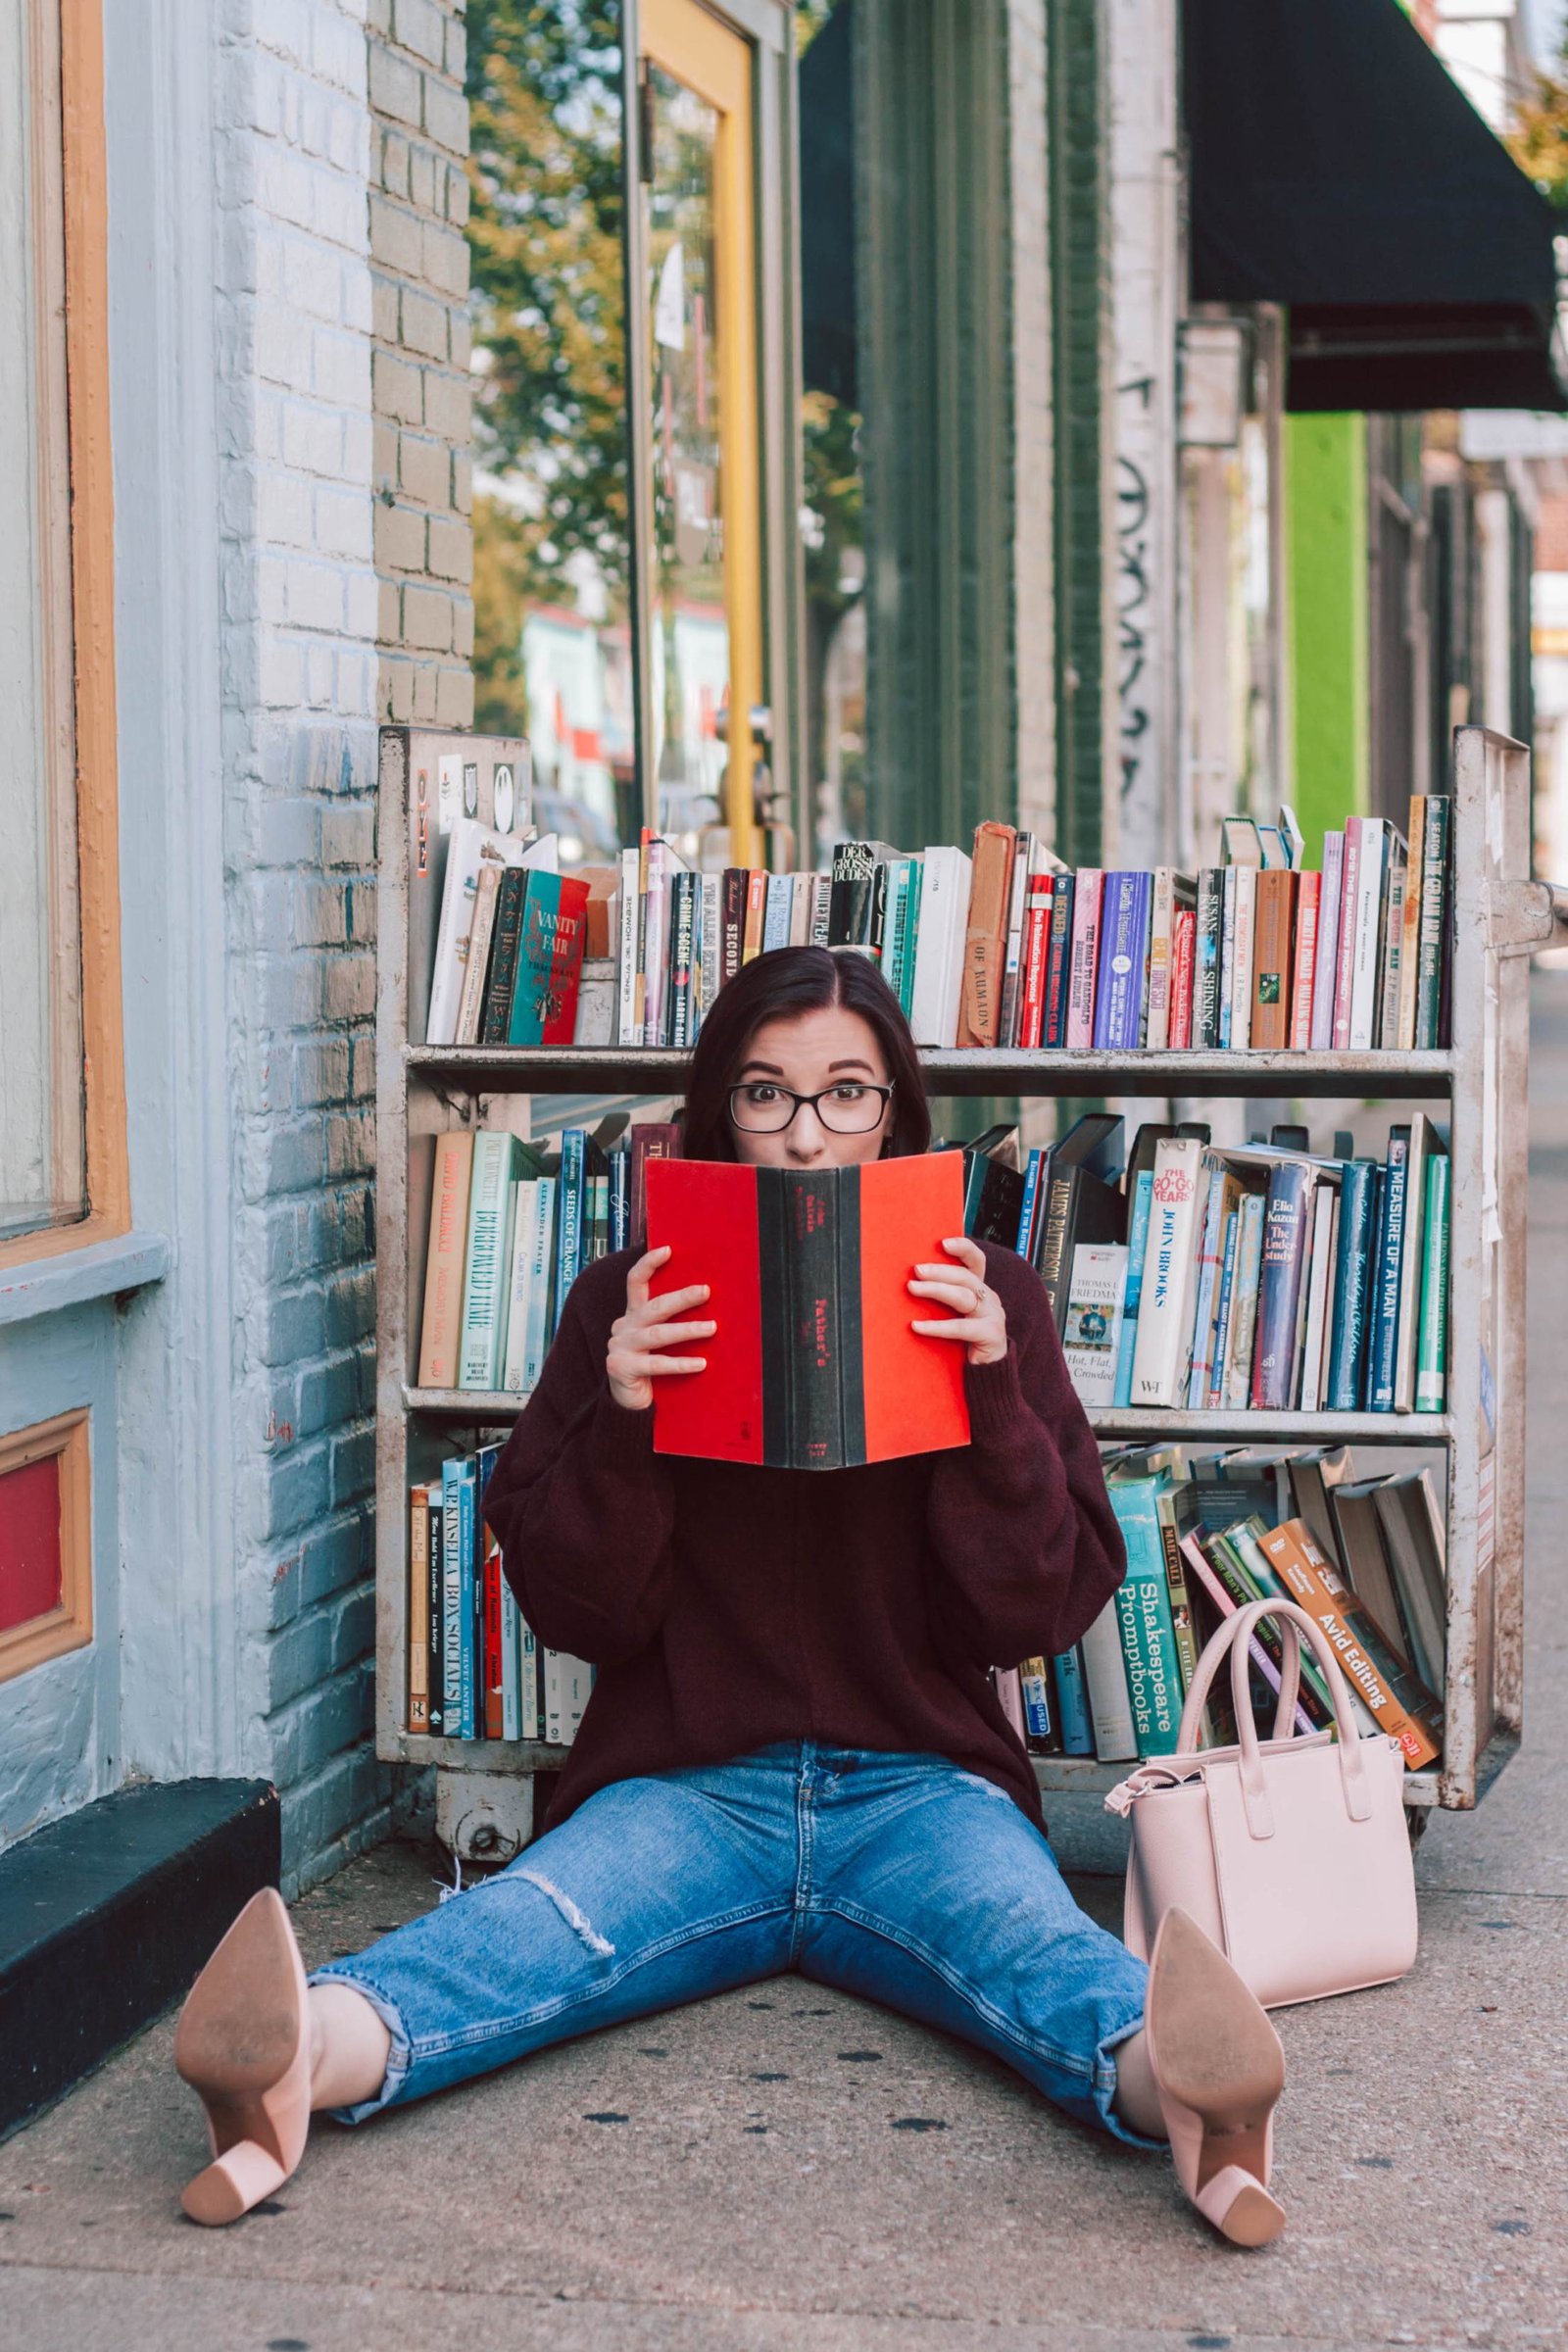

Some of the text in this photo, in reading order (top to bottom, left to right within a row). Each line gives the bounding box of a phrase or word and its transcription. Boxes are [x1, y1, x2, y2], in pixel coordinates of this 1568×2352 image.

[843, 847, 866, 858] DER
[1430, 822, 1442, 858] SEATON
[834, 868, 874, 882] DUDEN
[1347, 873, 1355, 894] THE
[1424, 859, 1443, 877] THE
[703, 883, 716, 947] TIM ALLEN
[815, 882, 832, 918] RIDLEY
[1054, 895, 1068, 936] DECKED
[1116, 883, 1134, 953] Kevin Trudeau
[1200, 893, 1209, 933] ISAACS
[1207, 894, 1219, 931] SUSAN
[1239, 903, 1248, 916] THE
[1424, 878, 1442, 918] GERMAN
[537, 909, 578, 936] VANITY
[677, 896, 696, 966] CRIME SCENE
[1181, 917, 1193, 965] Webster's
[1237, 917, 1248, 953] DOOMSDAY
[1390, 886, 1402, 969] THE GINGER MAN
[1422, 917, 1441, 945] ARMY
[543, 934, 568, 956] FAIR
[726, 923, 739, 977] SECOND
[1028, 909, 1043, 1003] the Relaxation Response
[974, 947, 989, 1028] OF KUMAON
[1048, 944, 1062, 1044] CAROL HIGGINS CLARK
[1072, 940, 1084, 1008] ROBERT LUDLUM
[1081, 924, 1096, 1025] THE ROAD TO GANDOLFO
[1151, 969, 1166, 1009] IONESCO
[1340, 949, 1350, 1002] PROPHECY
[676, 996, 686, 1024] LARRY
[1199, 971, 1216, 1030] SHINING
[1235, 986, 1245, 1013] Priestley
[1387, 992, 1396, 1031] DONLEAVY
[482, 1139, 503, 1200] PAUL MONETTE
[437, 1152, 461, 1253] DAVID BALDACCI
[1154, 1192, 1191, 1202] YEARS
[1267, 1210, 1298, 1224] Kazan
[1273, 1199, 1294, 1212] Elia
[535, 1183, 549, 1275] ALEXANDER FRATER
[563, 1189, 577, 1283] SEEDS OF CHANGE
[1041, 1178, 1070, 1282] JAMES PATTERSON
[1228, 1216, 1237, 1247] WAITING
[1271, 1226, 1290, 1239] The
[1382, 1171, 1404, 1318] MEASURE OF A MAN
[1439, 1222, 1449, 1260] PATRONS
[471, 1209, 502, 1290] BORROWED
[1154, 1208, 1176, 1308] JOHN BROOKS
[1225, 1253, 1235, 1272] EDEN
[1264, 1250, 1294, 1263] study
[435, 1266, 449, 1314] MEMORY
[1077, 1279, 1111, 1289] THOMAS
[467, 1295, 497, 1330] TIME
[1347, 1251, 1367, 1364] Thursday's Children
[1436, 1286, 1446, 1352] PERFORMANCE
[433, 1317, 446, 1346] MAN
[814, 1298, 830, 1367] Father's
[1217, 1324, 1227, 1361] ACKERMAN
[1067, 1354, 1112, 1368] Hot, Flat,
[1381, 1324, 1394, 1382] GREENFIELD
[1073, 1367, 1115, 1381] Crowded
[446, 1507, 460, 1575] KINSELLA
[1163, 1529, 1181, 1583] MAIL CALL
[489, 1585, 498, 1593] of
[1210, 1552, 1240, 1595] Poor Man's
[1286, 1567, 1305, 1594] Kennedy
[430, 1627, 439, 1653] Krieger
[446, 1584, 462, 1698] BOX SOCIALS
[1118, 1584, 1152, 1735] Promptbooks
[1139, 1583, 1171, 1733] Shakespeare
[1182, 1650, 1192, 1664] LEE
[1318, 1614, 1352, 1651] Avid
[1344, 1647, 1388, 1710] Editing
[462, 1646, 470, 1721] VELVET ANTLER
[1037, 1704, 1048, 1732] USED
